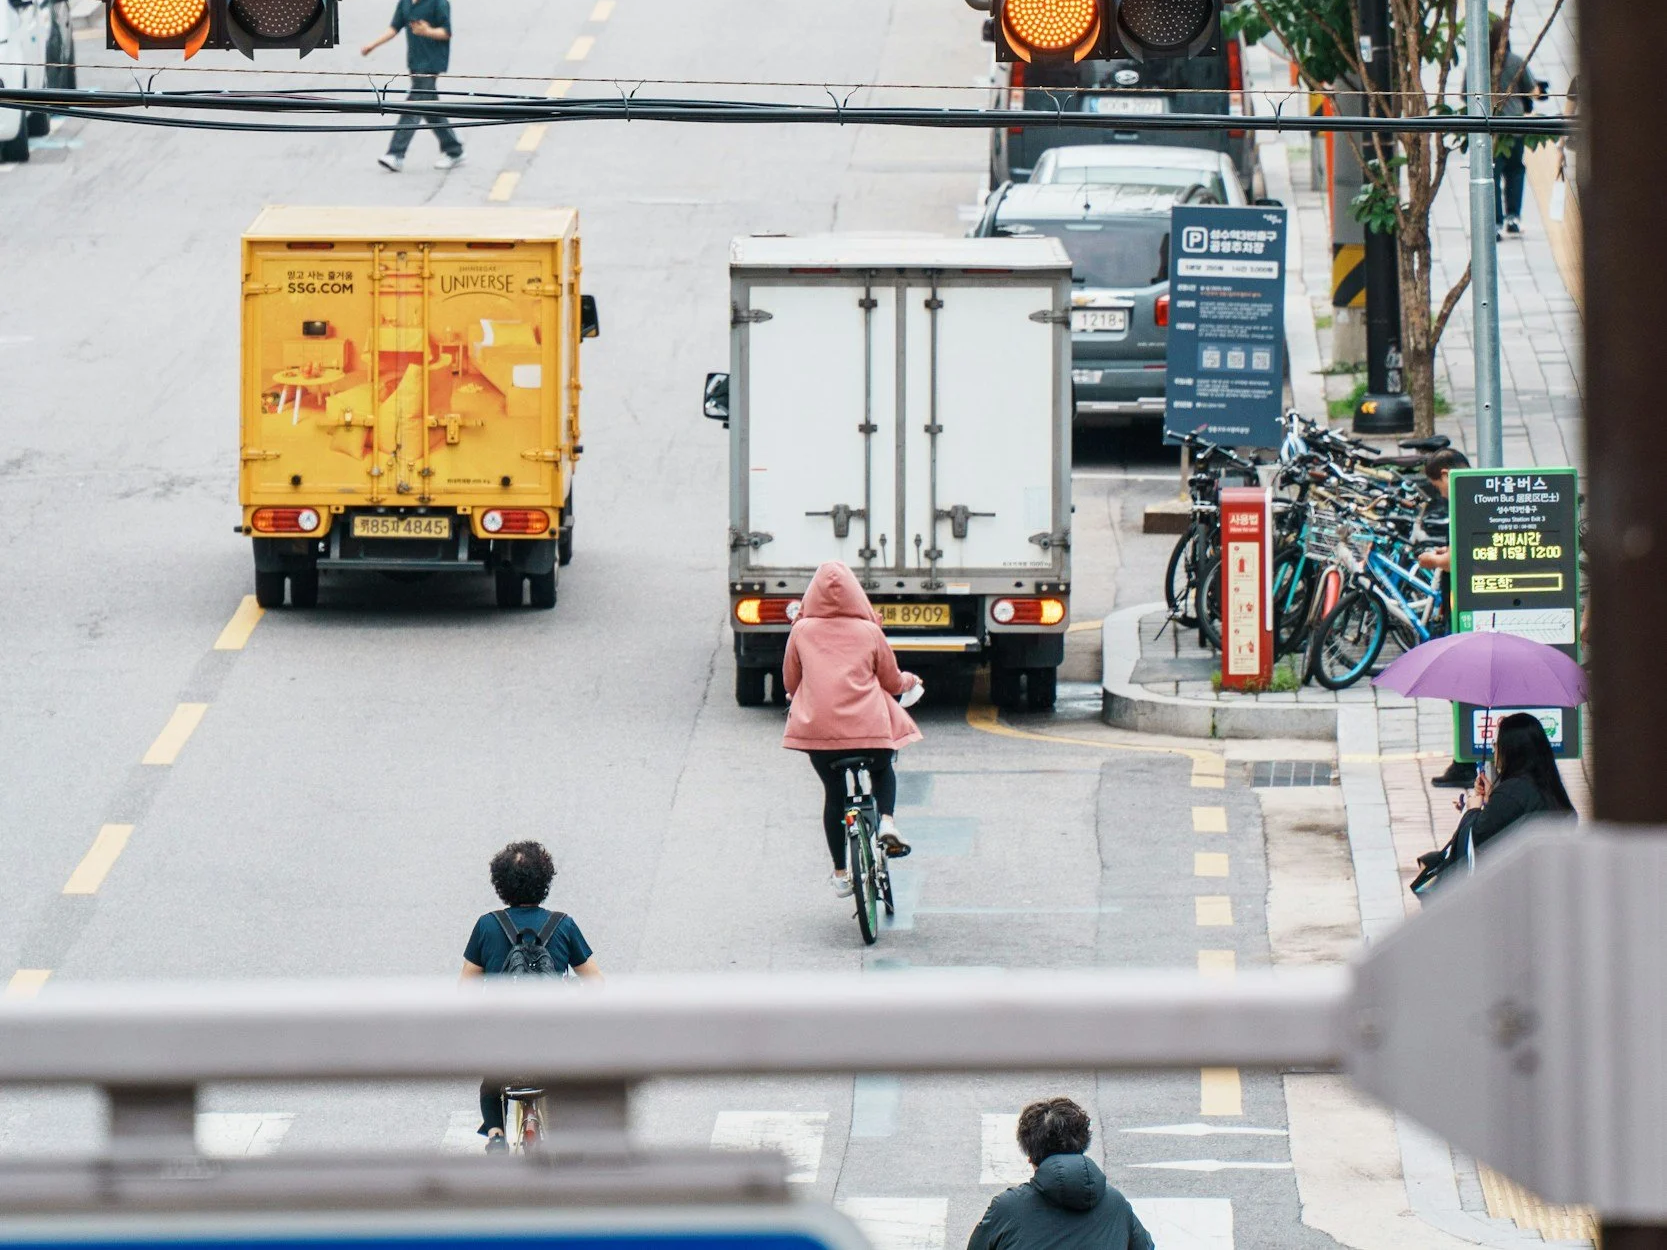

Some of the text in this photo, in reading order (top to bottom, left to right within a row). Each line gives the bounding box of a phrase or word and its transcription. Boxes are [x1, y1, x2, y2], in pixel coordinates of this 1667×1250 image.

[1189, 231, 1203, 248] P
[308, 271, 324, 280] 사는
[287, 283, 354, 294] SSG.COM
[441, 274, 514, 294] UNIVERSE
[1486, 476, 1548, 492] 마을버스
[1474, 494, 1499, 504] (Town
[1500, 494, 1515, 503] Bus
[403, 519, 443, 535] 4845
[1229, 512, 1259, 526] 사용법
[1492, 531, 1541, 546] 현재시간
[1473, 545, 1561, 561] 06월 15일 12:00
[901, 606, 943, 622] 8909
